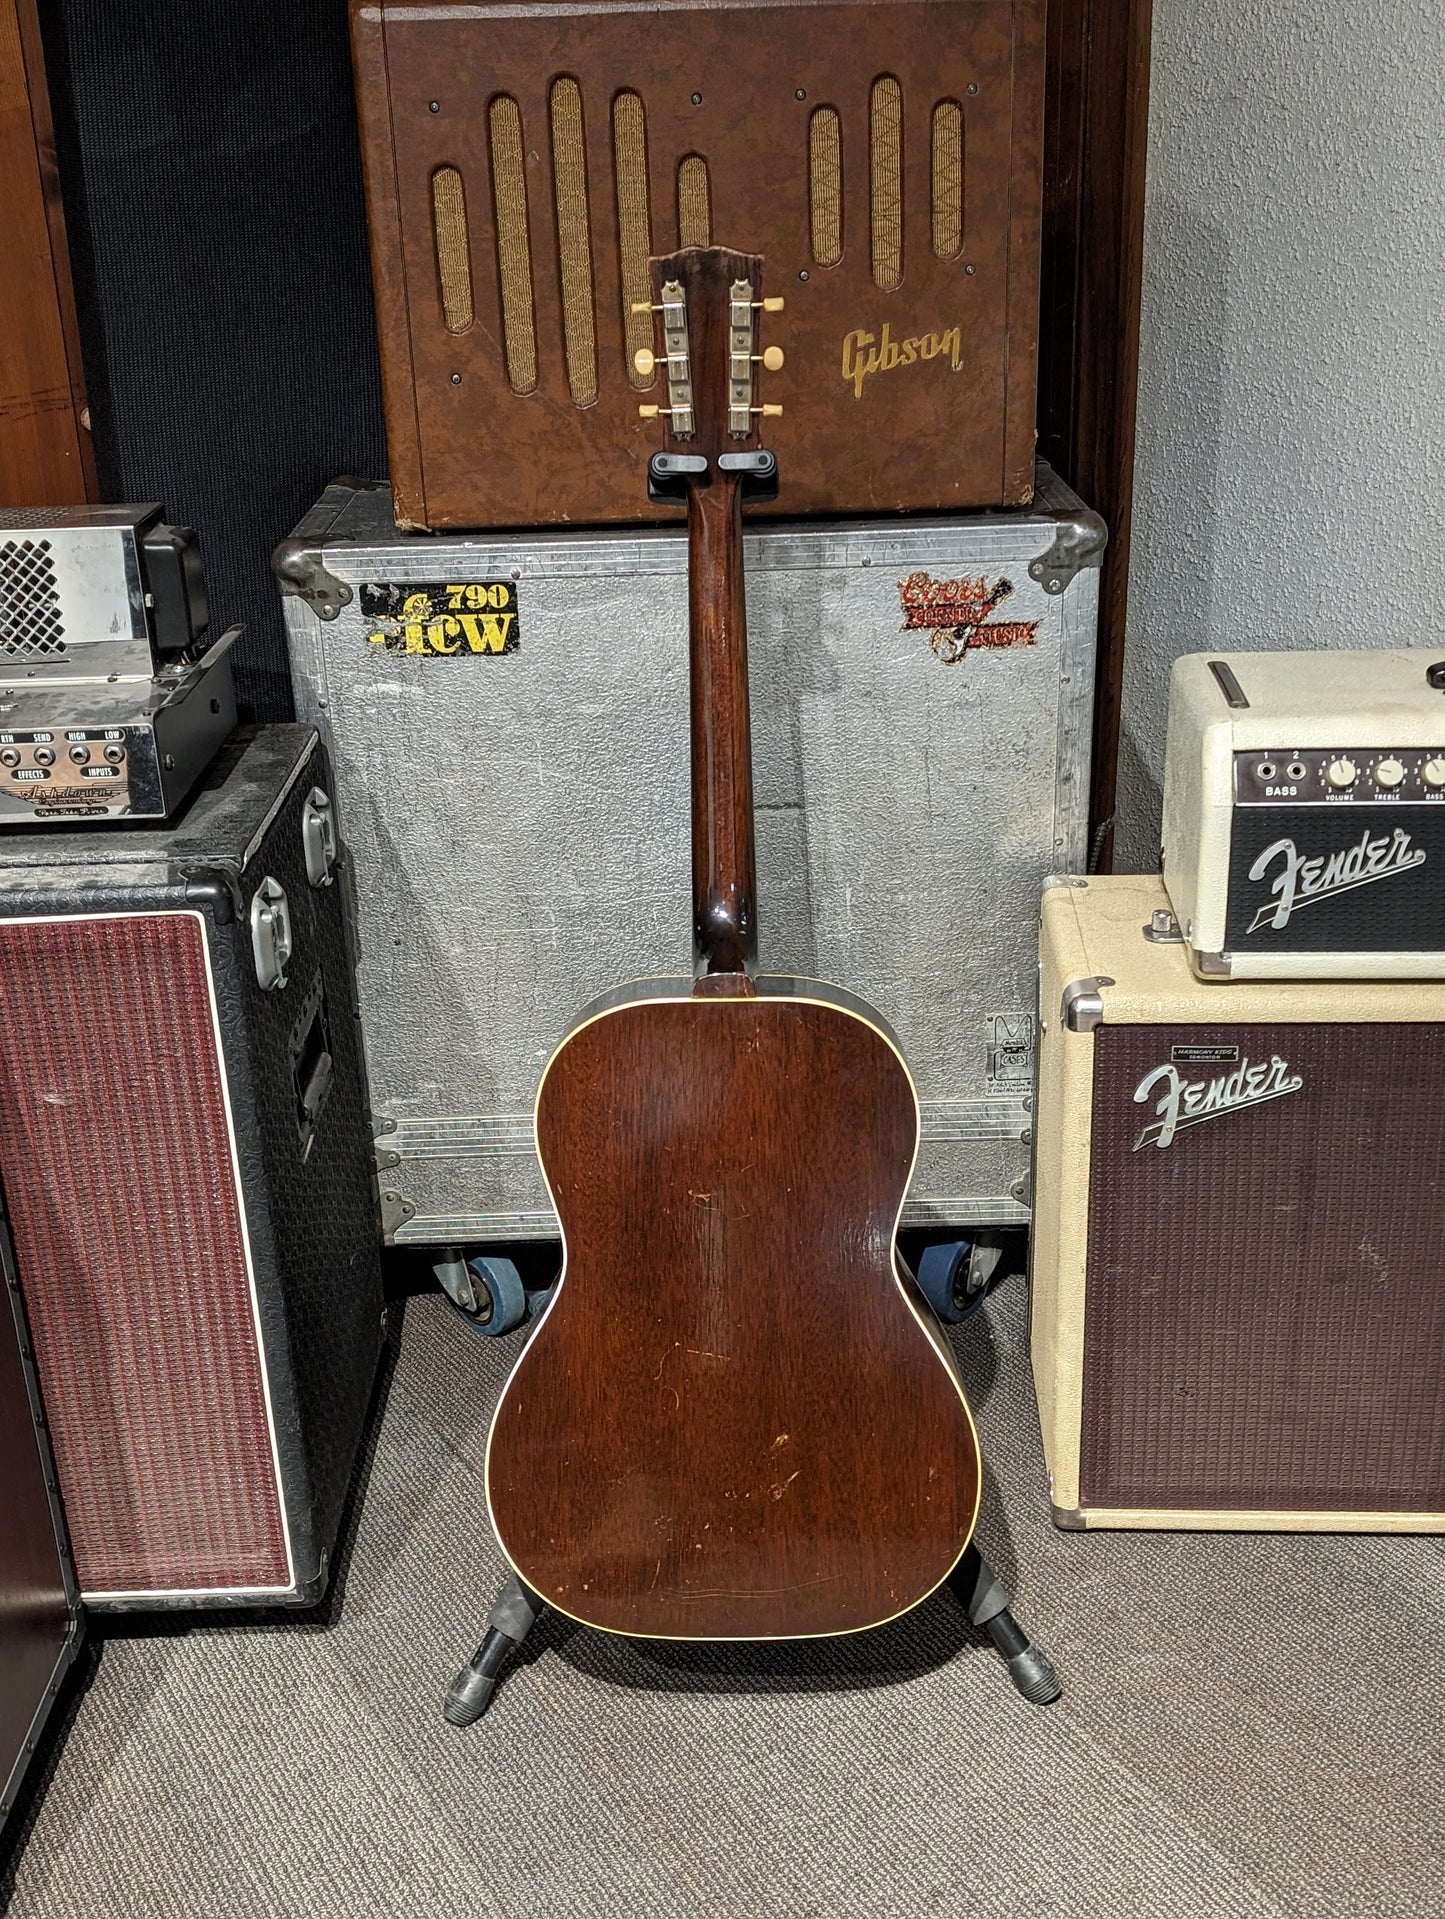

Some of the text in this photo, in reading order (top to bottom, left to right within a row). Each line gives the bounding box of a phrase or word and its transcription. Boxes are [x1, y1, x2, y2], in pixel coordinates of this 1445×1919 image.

[842, 322, 963, 398] Gibson
[446, 584, 509, 608] 790
[33, 733, 51, 742] SEND
[68, 730, 120, 740] HIGH LOW
[1263, 750, 1300, 760] 1 2
[17, 770, 44, 779] EFFECTS
[88, 767, 113, 776] INPUTS
[21, 784, 113, 799] Ashdown
[1265, 786, 1297, 796] BASS
[1374, 793, 1401, 801] TREBLE
[1247, 828, 1426, 934] Fender
[1002, 1054, 1026, 1065] CASES
[1133, 1056, 1303, 1152] Fender
